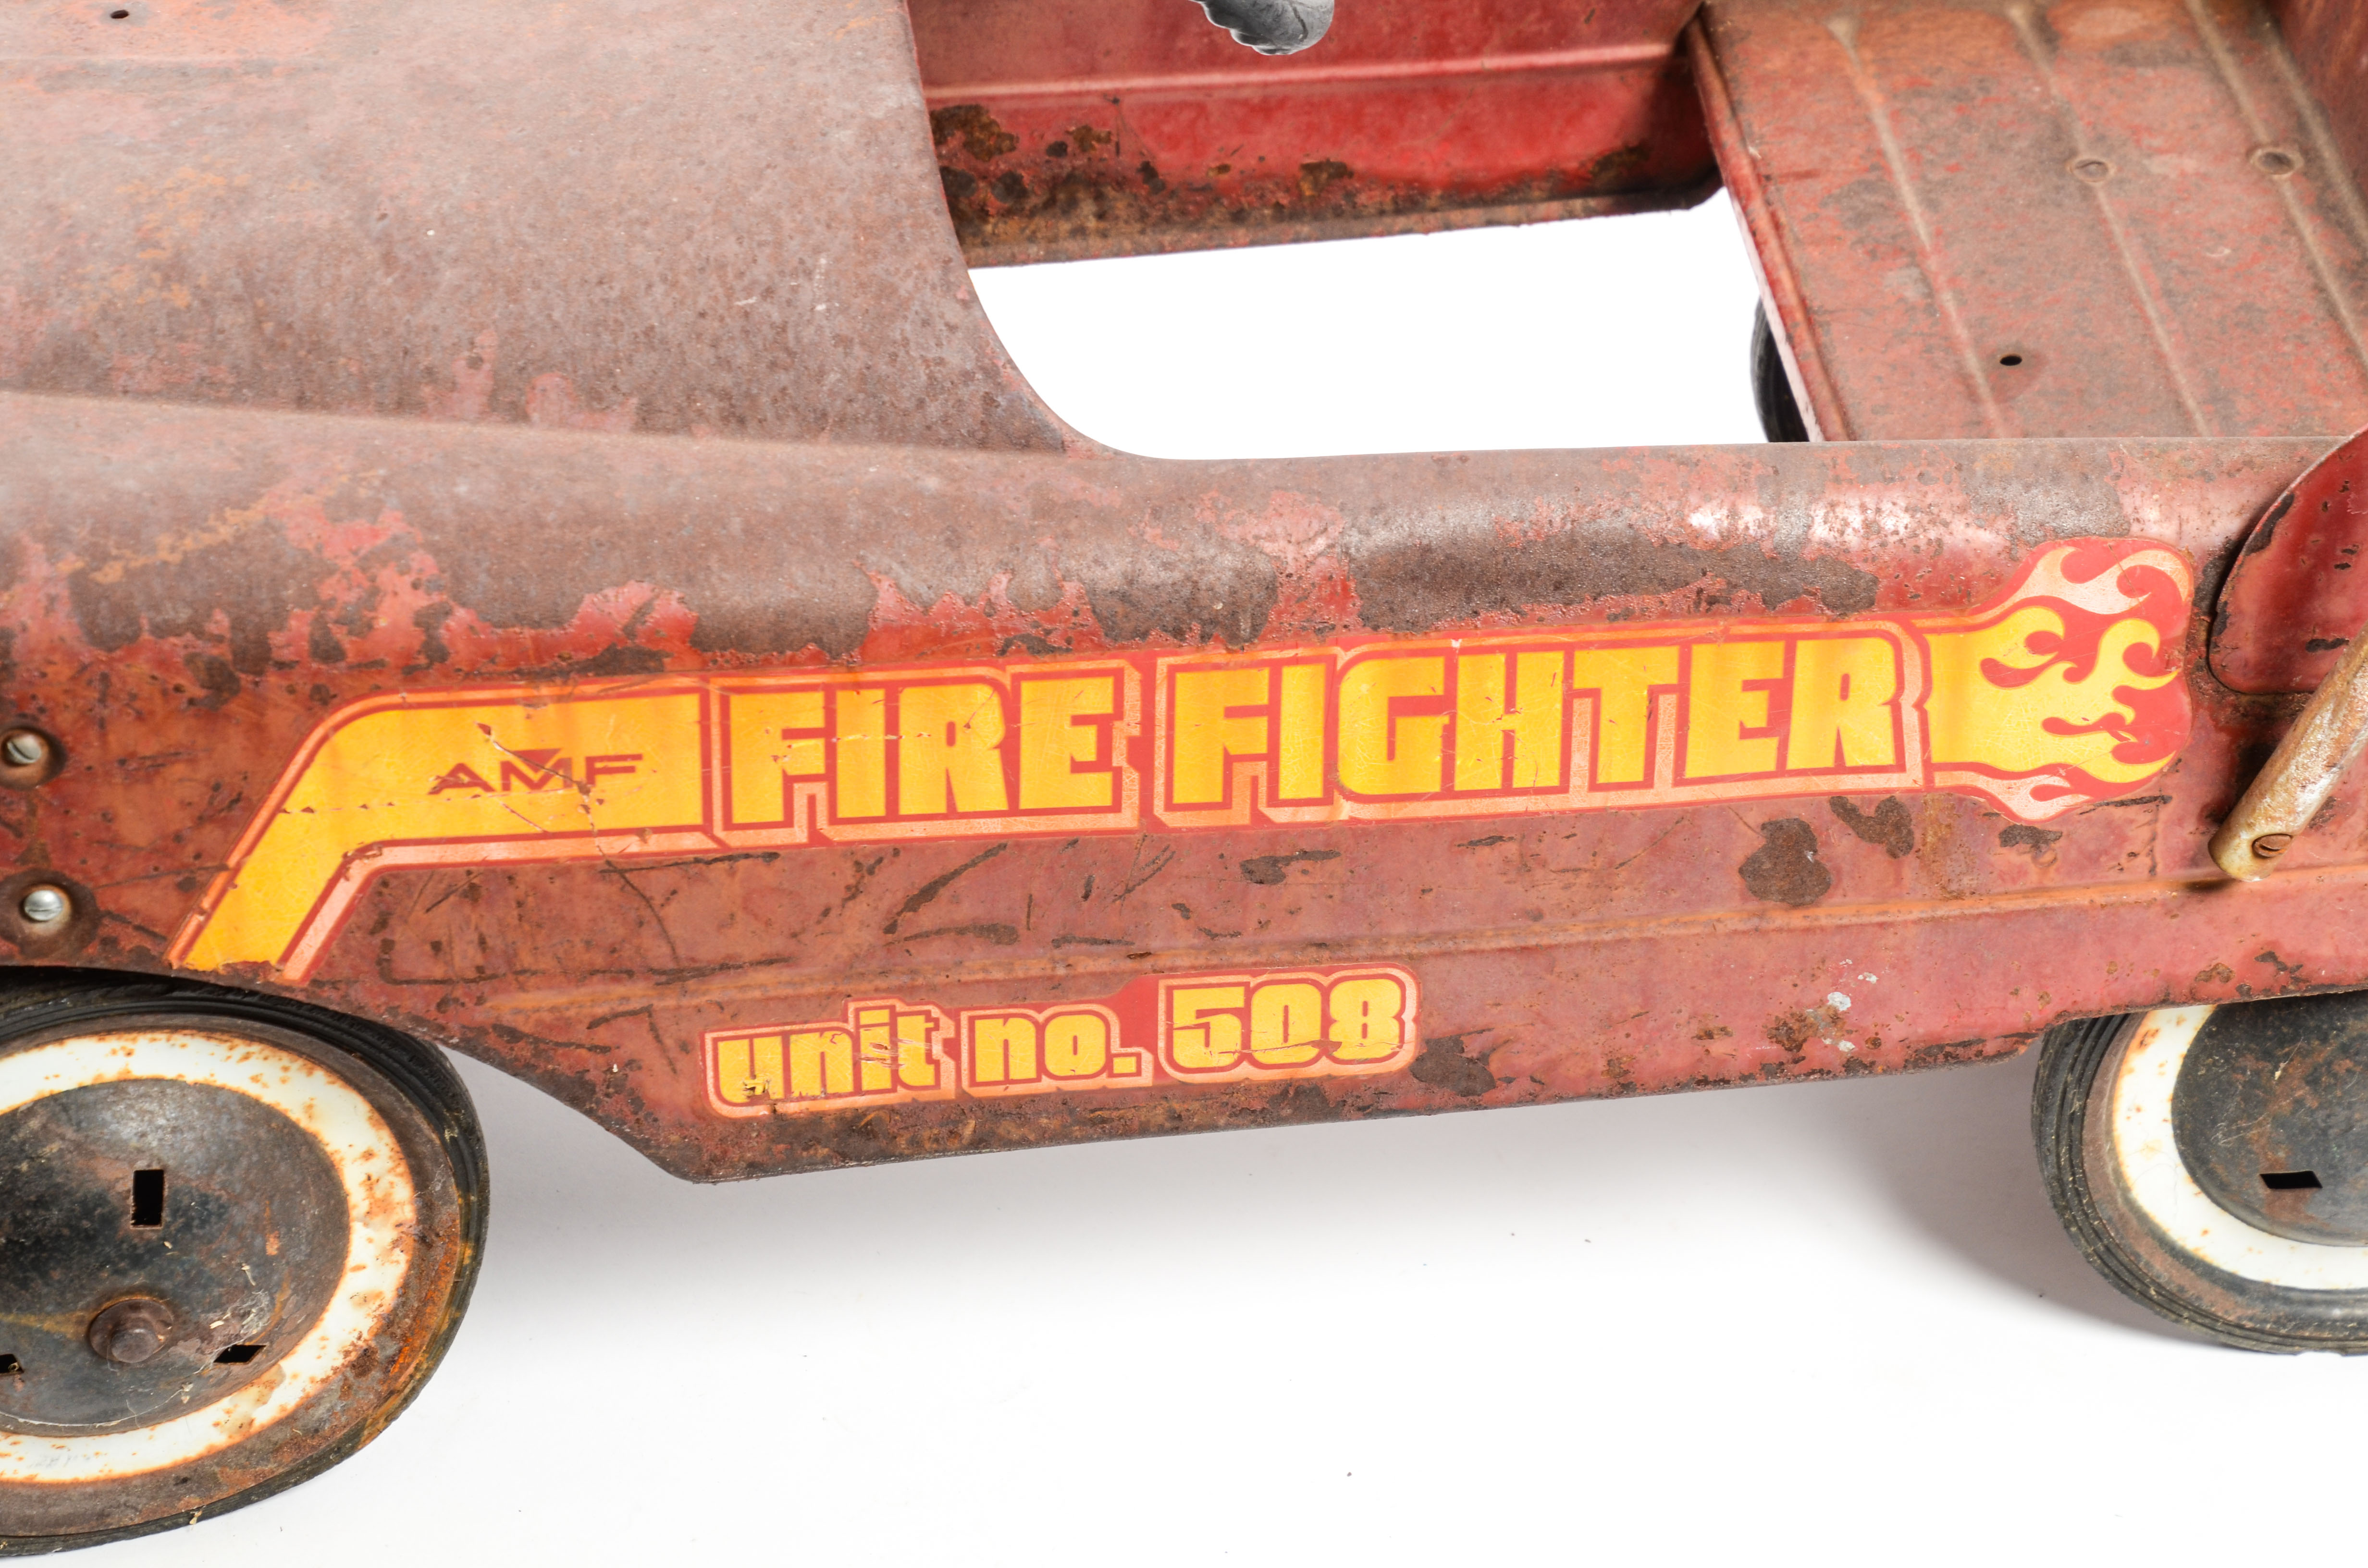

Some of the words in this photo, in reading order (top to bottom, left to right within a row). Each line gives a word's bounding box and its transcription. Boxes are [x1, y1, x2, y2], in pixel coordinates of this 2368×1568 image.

[427, 748, 643, 795] AMF
[729, 676, 1114, 824] FIRE
[1171, 637, 1896, 804] FIGHTER
[717, 1008, 938, 1104] unit
[974, 1014, 1136, 1083] no.
[1172, 978, 1402, 1068] 508
